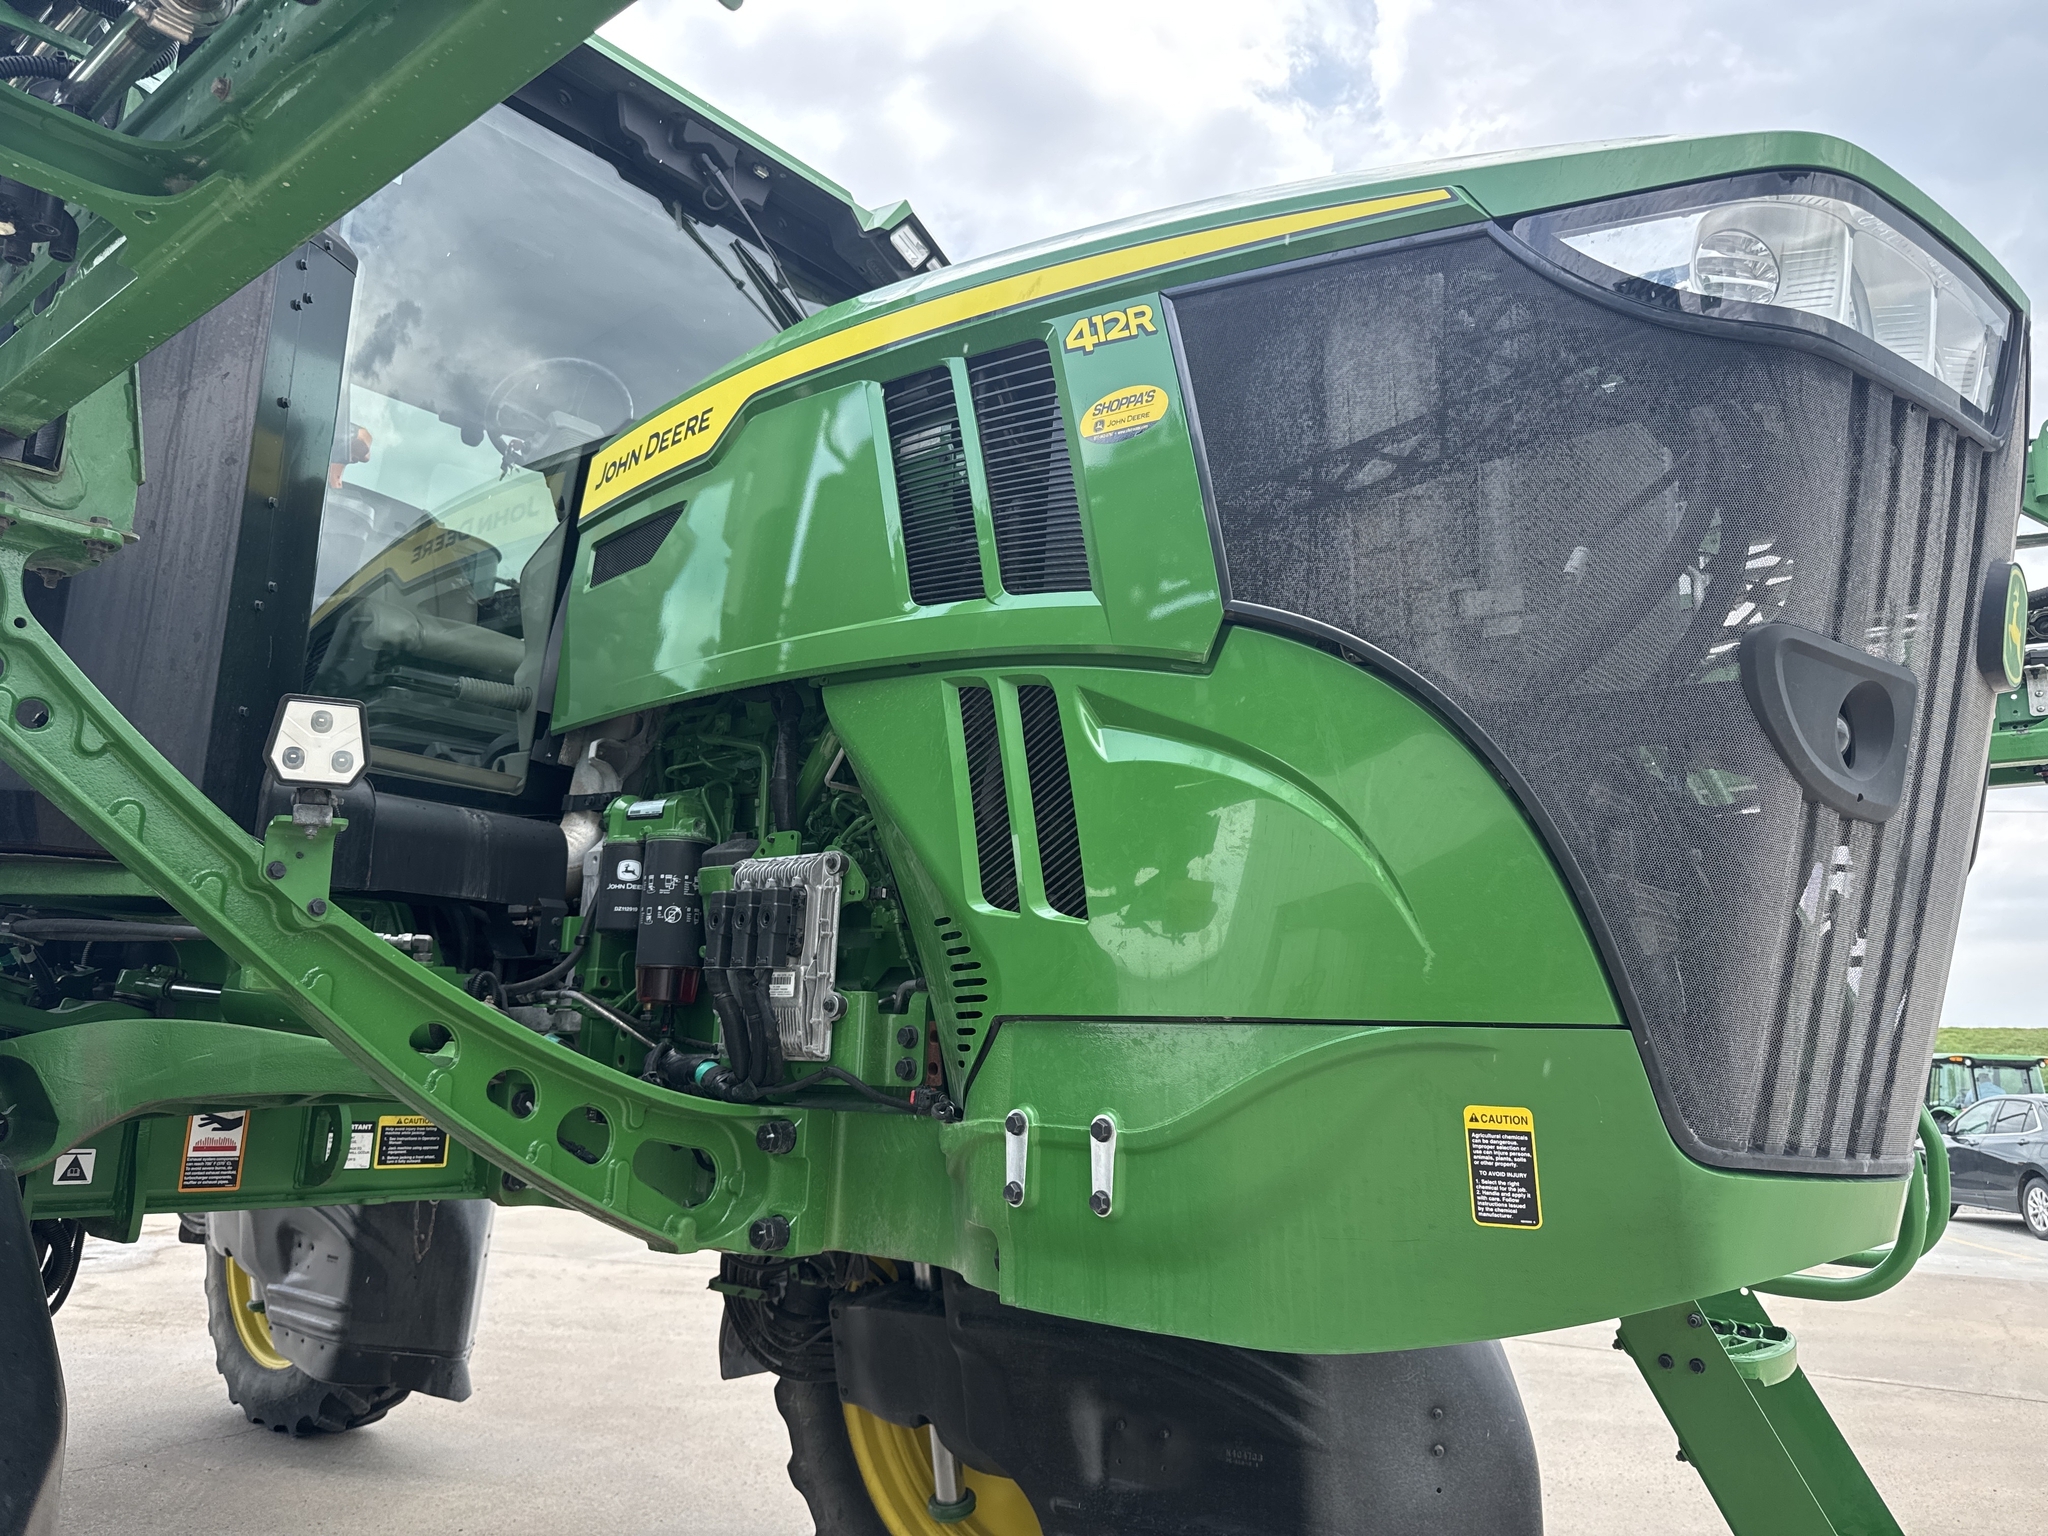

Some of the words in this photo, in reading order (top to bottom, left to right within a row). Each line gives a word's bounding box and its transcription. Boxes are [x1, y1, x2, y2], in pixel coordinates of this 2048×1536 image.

[1064, 304, 1158, 356] 412R
[1092, 389, 1156, 416] SHOPPA'S
[1107, 417, 1126, 428] JOHN
[1127, 412, 1151, 423] DEERE
[594, 444, 643, 491] JOHN
[644, 406, 714, 461] DEERE
[606, 882, 626, 890] JOHN
[1480, 1113, 1528, 1125] CAUTION
